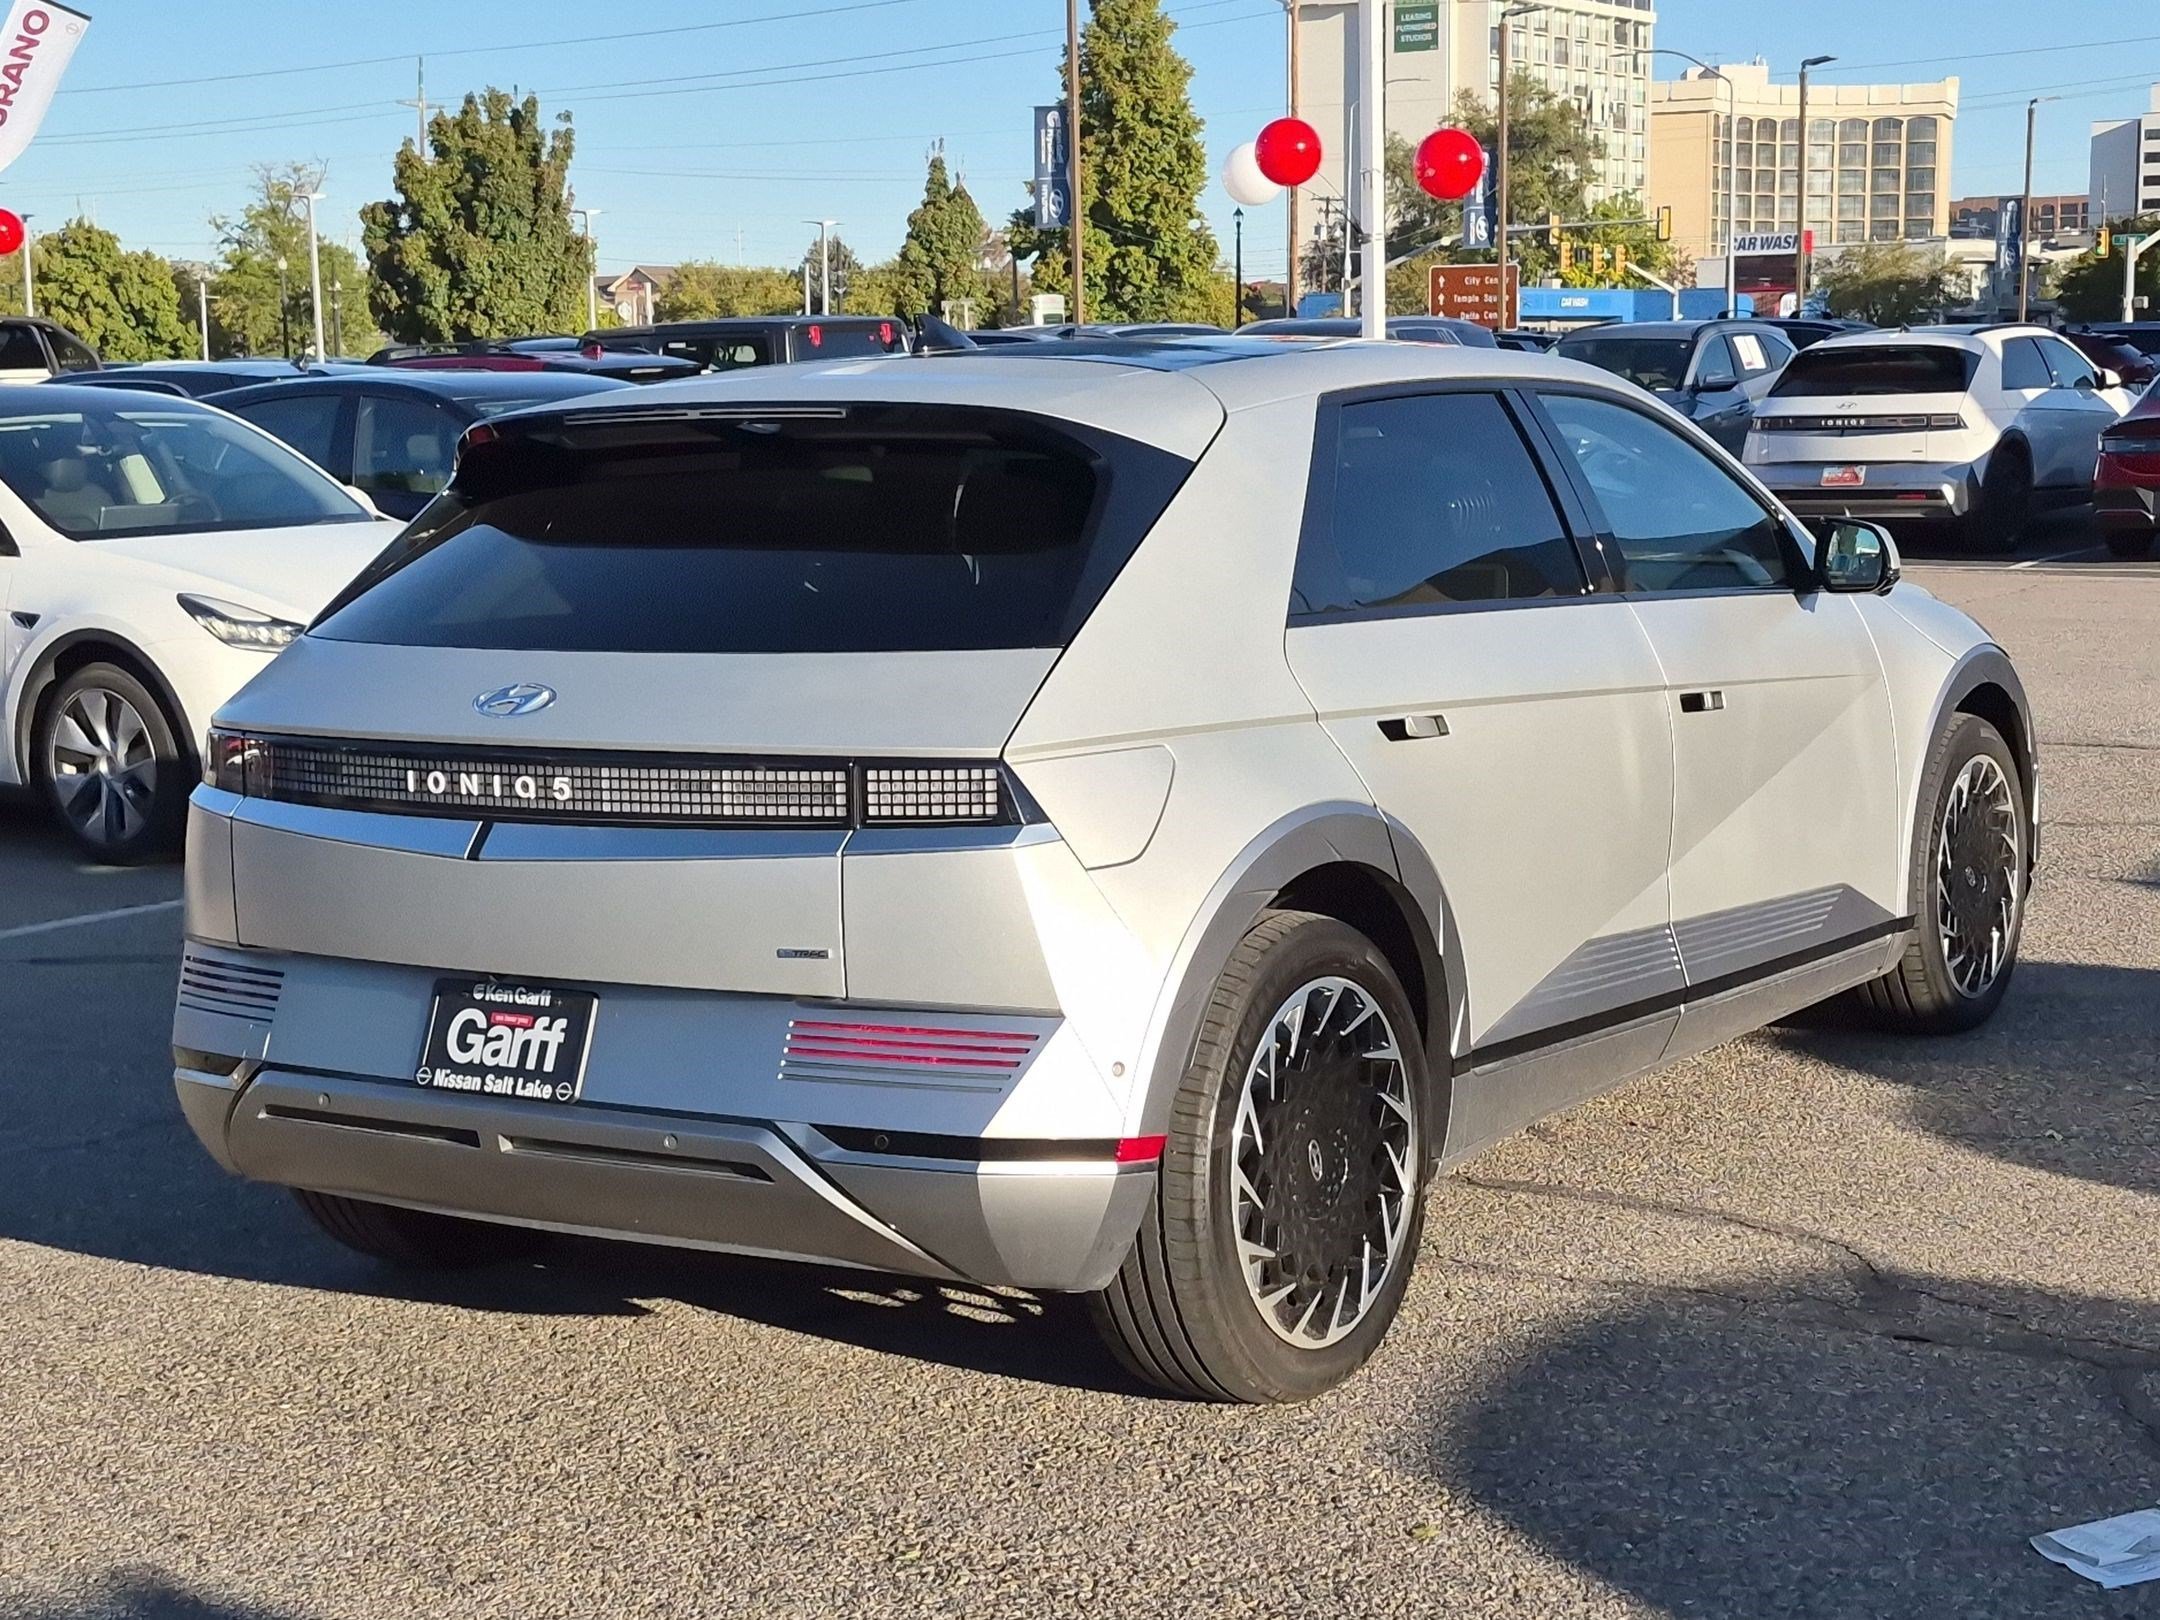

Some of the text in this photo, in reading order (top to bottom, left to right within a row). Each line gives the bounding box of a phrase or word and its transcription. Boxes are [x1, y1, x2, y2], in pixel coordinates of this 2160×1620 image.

[1464, 276, 1509, 287] City Cenr
[1454, 293, 1509, 304] Temple Sque
[1484, 311, 1509, 320] Cenr
[407, 770, 571, 801] IONIQ 5
[485, 984, 552, 1007] Ken Garff
[447, 1008, 568, 1073] Garff
[433, 1068, 553, 1099] Nissan Salt Lake
